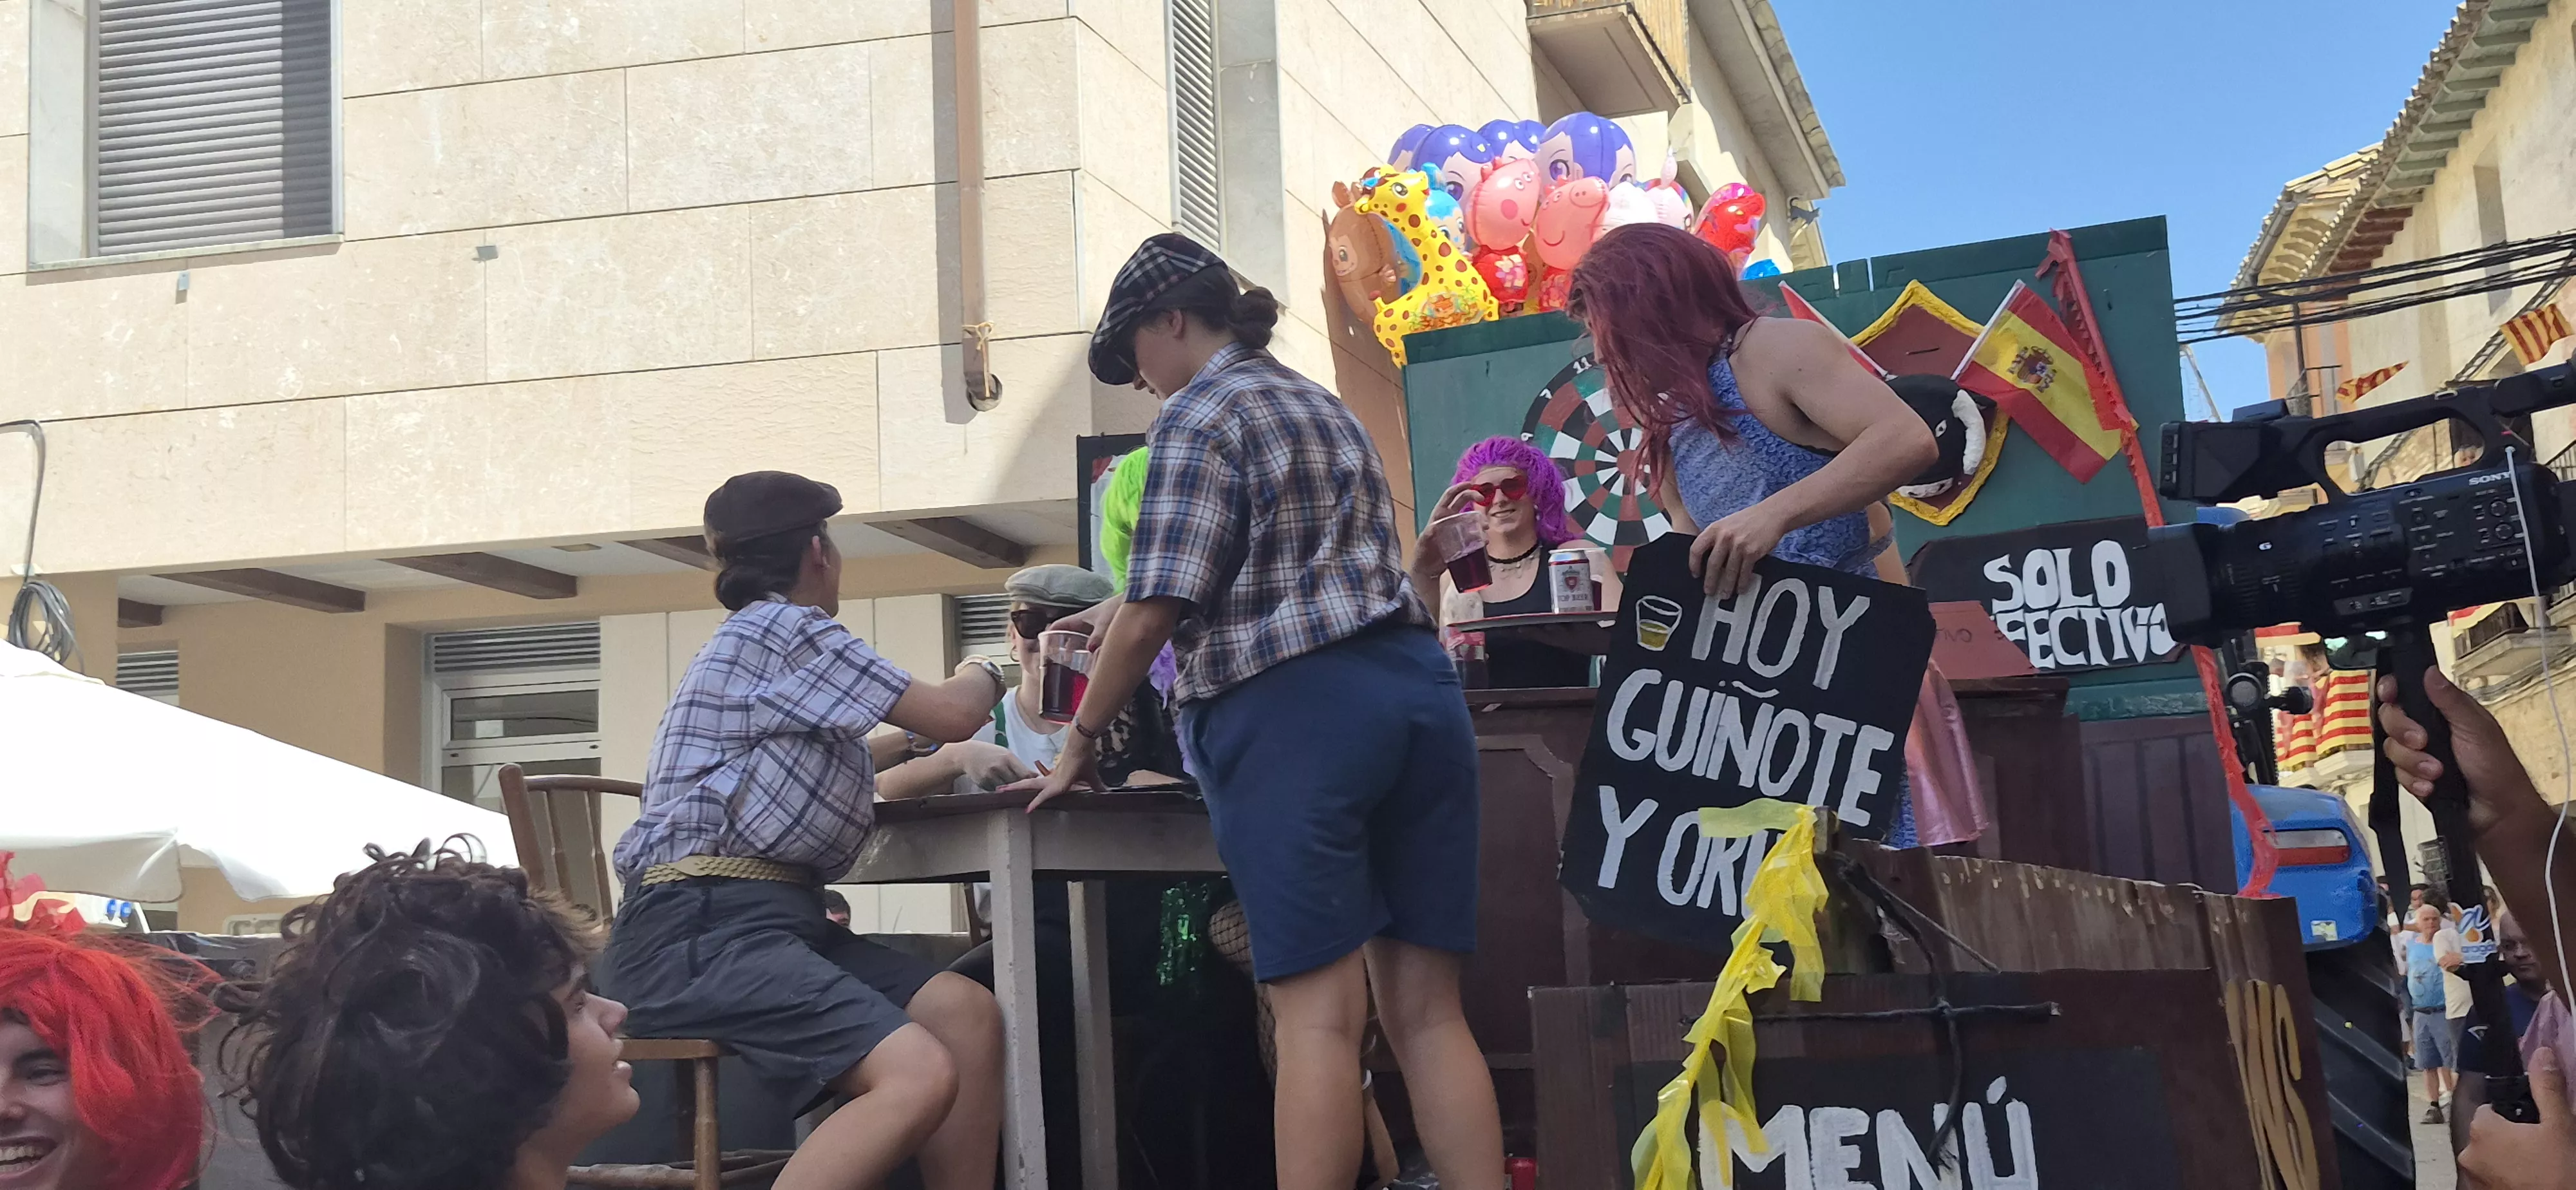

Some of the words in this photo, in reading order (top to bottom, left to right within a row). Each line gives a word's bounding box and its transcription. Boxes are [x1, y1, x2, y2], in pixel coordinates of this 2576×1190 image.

[1573, 356, 1592, 374] 11
[2468, 470, 2510, 486] SONY
[1984, 540, 2130, 614] SOLO
[1691, 572, 1870, 690] HOY
[1607, 668, 1894, 827] GUIÑOTE
[1598, 785, 1659, 889] Y
[1698, 1075, 2040, 1190] MENÚ
